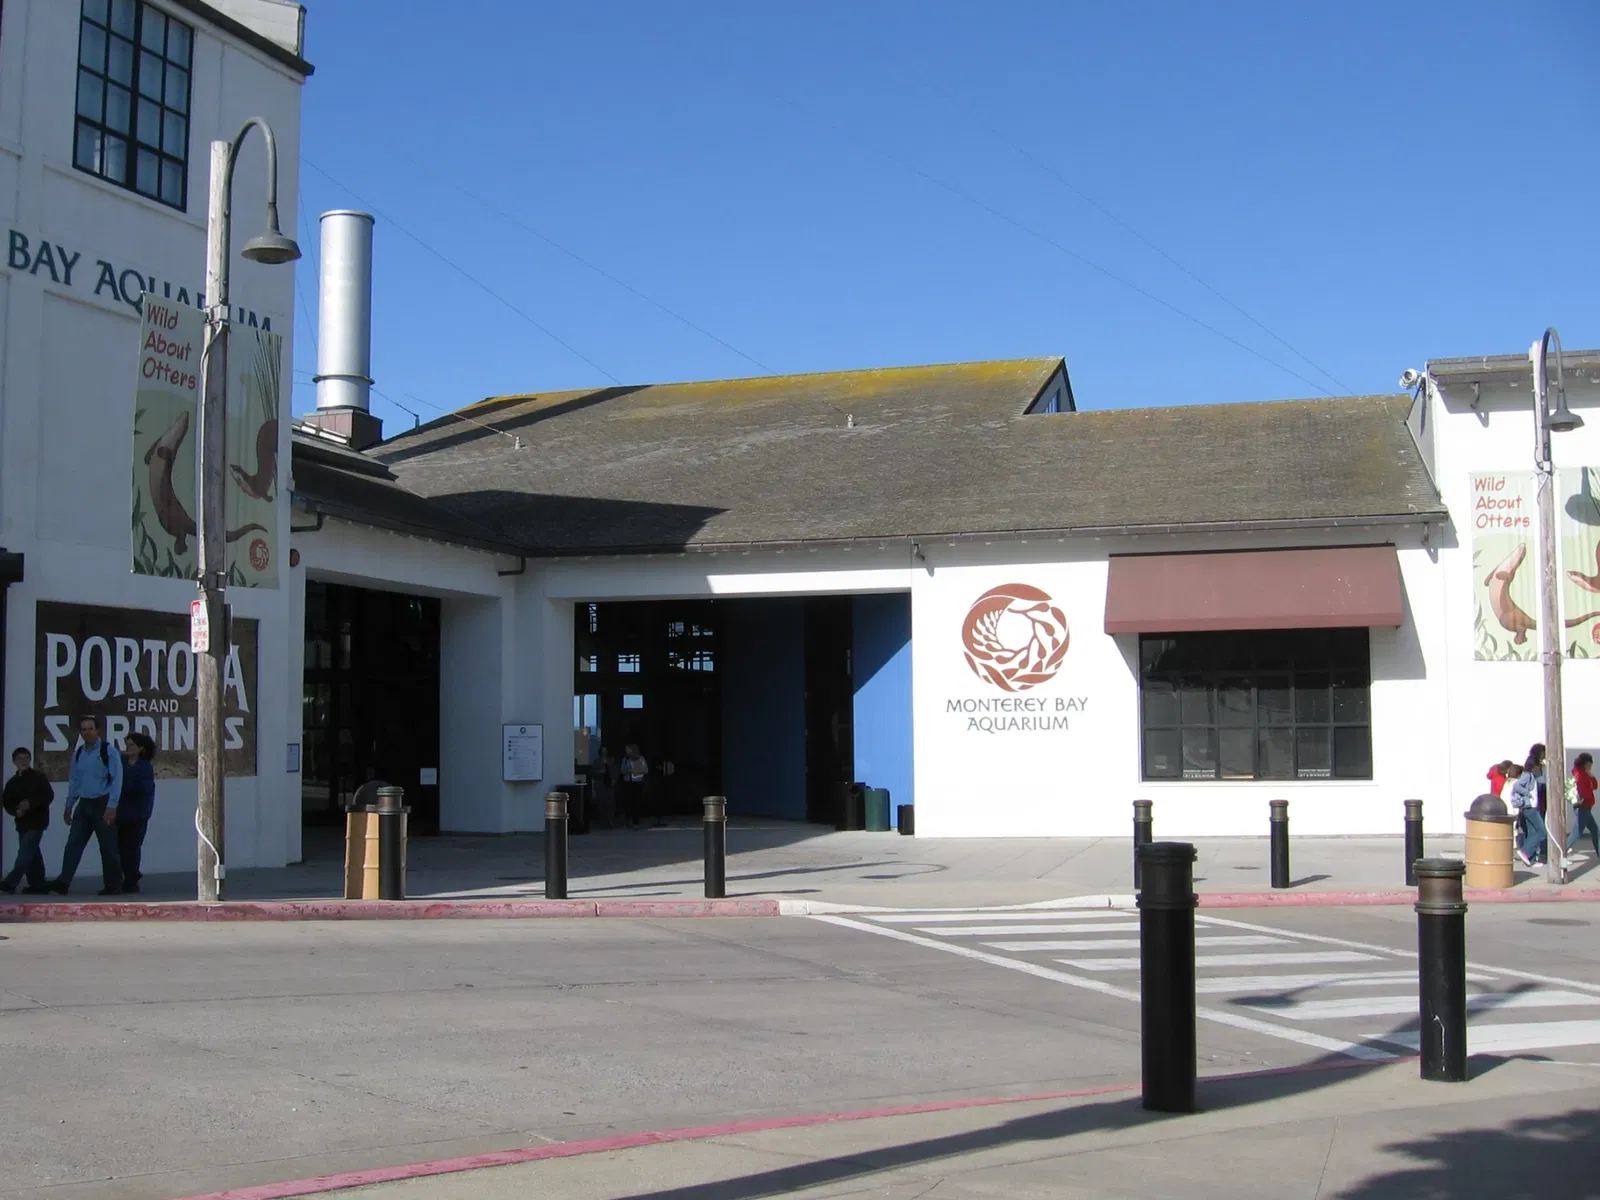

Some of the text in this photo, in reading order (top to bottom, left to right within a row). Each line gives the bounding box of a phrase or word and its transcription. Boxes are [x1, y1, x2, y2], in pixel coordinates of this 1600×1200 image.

[8, 228, 81, 286] BAY
[147, 303, 178, 330] Wild
[144, 330, 192, 361] About
[142, 357, 196, 390] Otters
[1474, 476, 1505, 491] Wild
[1475, 495, 1522, 509] About
[1476, 513, 1531, 528] Otters
[44, 632, 250, 712] PORTOA
[127, 699, 179, 713] BRAND
[946, 697, 1088, 712] MONTEREY BAY
[43, 715, 244, 751] SRDINS
[967, 716, 1069, 733] AQUARIUM
